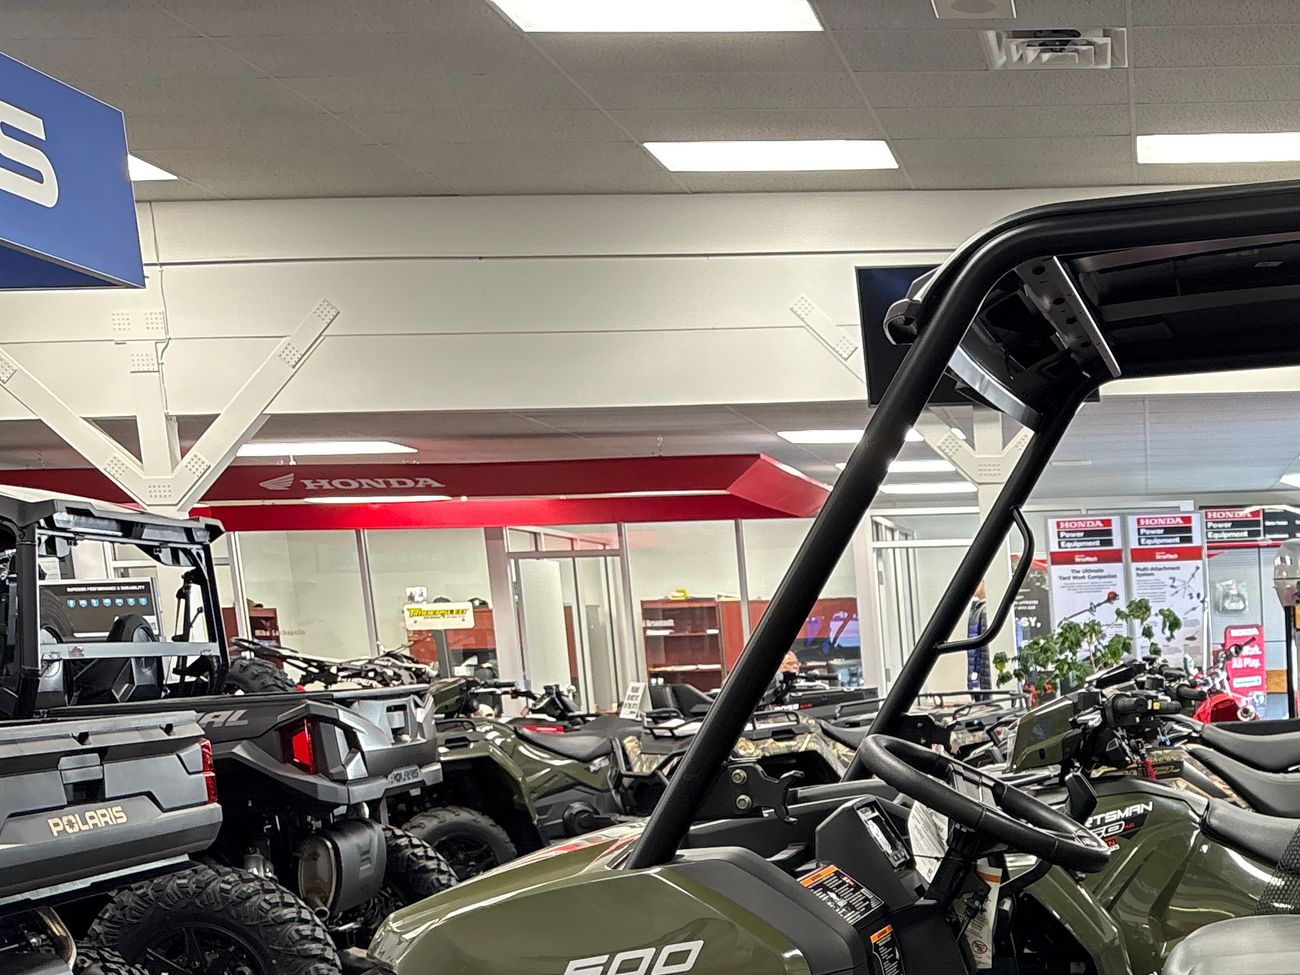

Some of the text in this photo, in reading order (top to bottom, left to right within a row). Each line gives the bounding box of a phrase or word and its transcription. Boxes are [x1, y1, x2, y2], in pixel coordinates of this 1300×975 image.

[300, 478, 446, 490] HONDA
[1207, 510, 1253, 519] HONDA
[1059, 520, 1104, 529] HONDA
[1140, 517, 1184, 526] HONDA
[1207, 521, 1232, 529] Power
[1140, 528, 1164, 536] Power
[1207, 531, 1248, 539] Equipment
[1060, 540, 1101, 549] Equipment
[1140, 537, 1181, 546] Equipment
[48, 806, 127, 836] POLARIS
